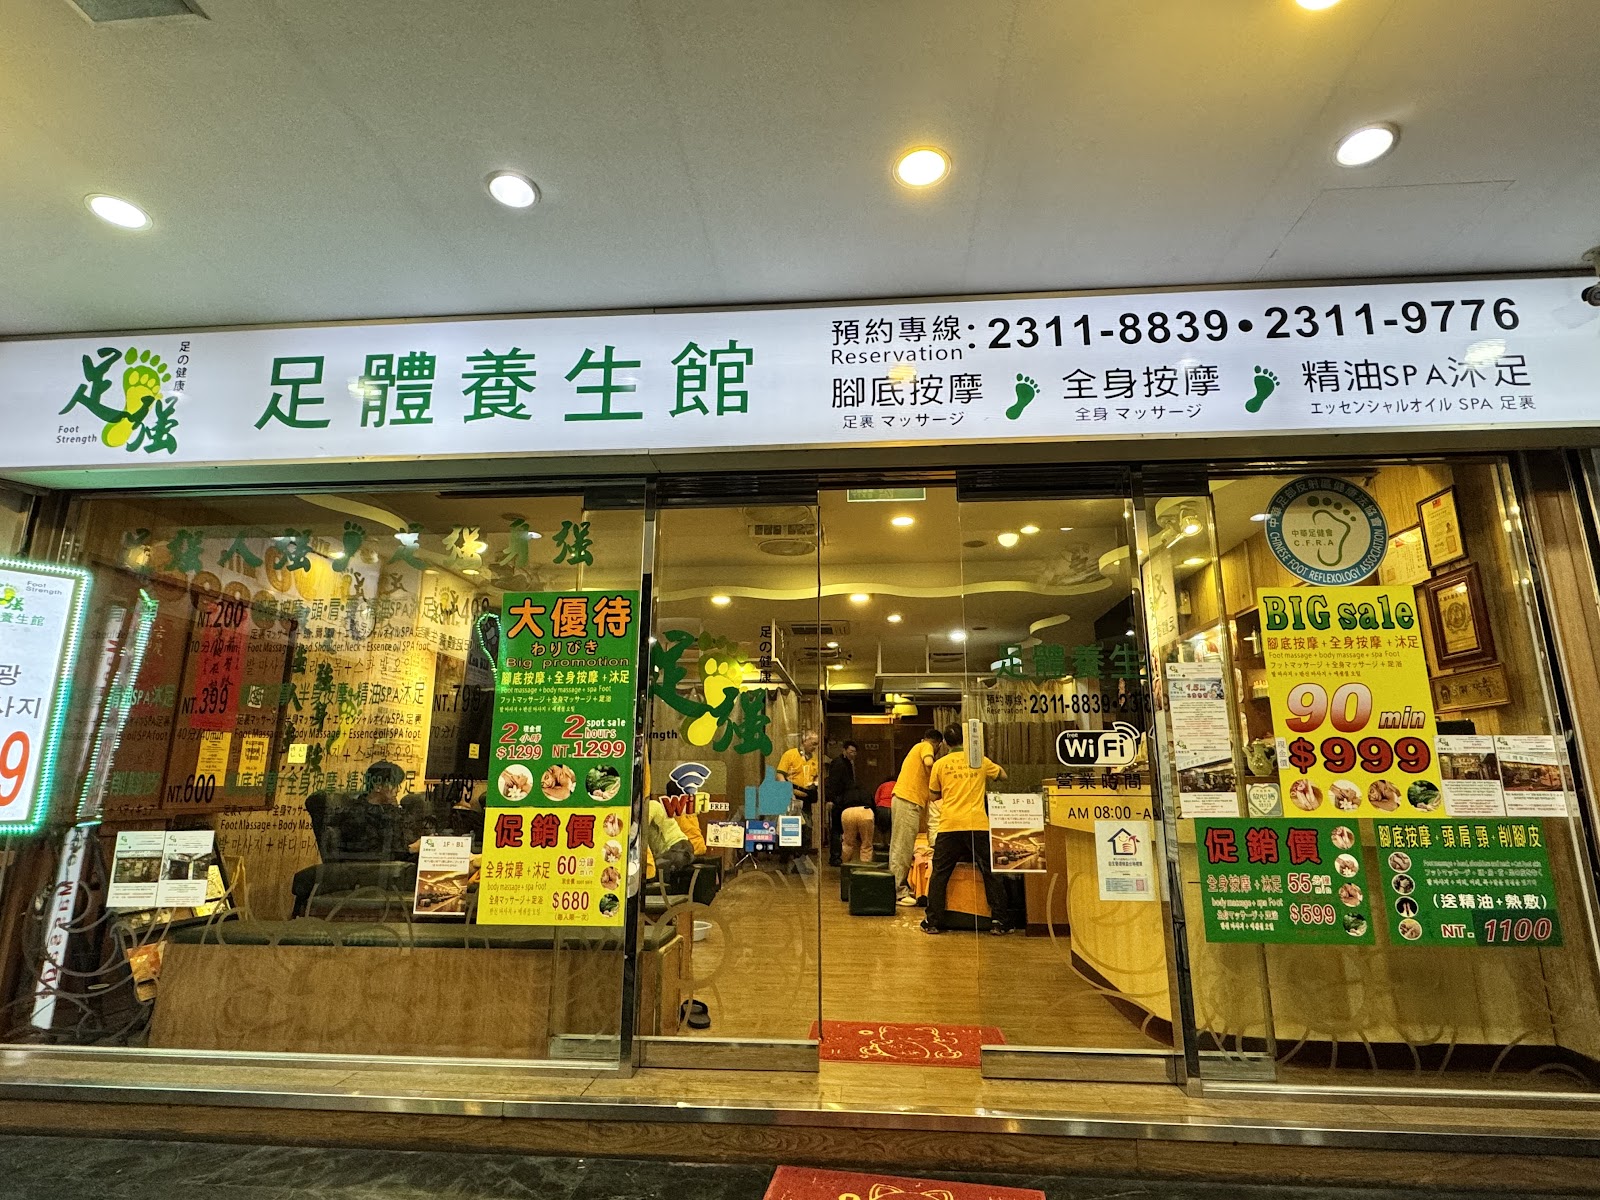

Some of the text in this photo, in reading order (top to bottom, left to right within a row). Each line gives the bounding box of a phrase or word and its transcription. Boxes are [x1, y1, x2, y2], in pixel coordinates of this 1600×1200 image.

[831, 346, 963, 365] Reservation
[173, 341, 191, 391] 足の健康
[253, 339, 753, 430] 足體養生館
[832, 372, 983, 408] 腳底按摩
[1062, 365, 1220, 400] 全身按摩
[1075, 403, 1202, 421] 全身 マッサージ
[1311, 395, 1537, 415] エッセンシャルオイル SPA 足裏
[57, 425, 79, 434] Foot
[843, 412, 965, 428] 足裏 マッサージ
[56, 434, 97, 444] Strength
[1270, 529, 1383, 583] CHINESE FOOT REFLEXOLOGY ASSOCIATION
[506, 596, 632, 639] 大優待
[1263, 595, 1414, 631] BIG sale
[531, 640, 599, 656] わりびき
[759, 626, 777, 683] 足の健康
[1285, 653, 1312, 661] massage
[1319, 651, 1335, 659] body
[1337, 653, 1364, 661] massage
[1371, 652, 1383, 660] spa
[506, 657, 629, 669] Big promotion
[182, 688, 229, 714] NT.399
[514, 687, 537, 695] massage
[543, 687, 557, 695] body
[558, 687, 581, 695] massage
[1285, 682, 1426, 733] 90 min
[499, 722, 520, 744] 2
[562, 715, 617, 739] 2 hours
[587, 718, 626, 728] spot sale
[350, 729, 378, 741] Essence
[496, 744, 543, 761] $1299
[552, 740, 626, 759] NT.1299
[1288, 736, 1432, 774] $999
[167, 774, 215, 804] NT.600
[1056, 772, 1142, 791] 營業時間
[711, 803, 729, 812] FREE
[1068, 806, 1131, 823] AM 08:00
[221, 821, 237, 832] Foot
[278, 820, 297, 834] Body
[494, 813, 596, 849] 促銷價
[1204, 826, 1323, 865] 促銷價
[557, 855, 577, 875] 60
[1287, 873, 1312, 894] 55
[552, 891, 589, 911] $680
[1290, 903, 1336, 925] $599
[1485, 917, 1553, 943] 1100
